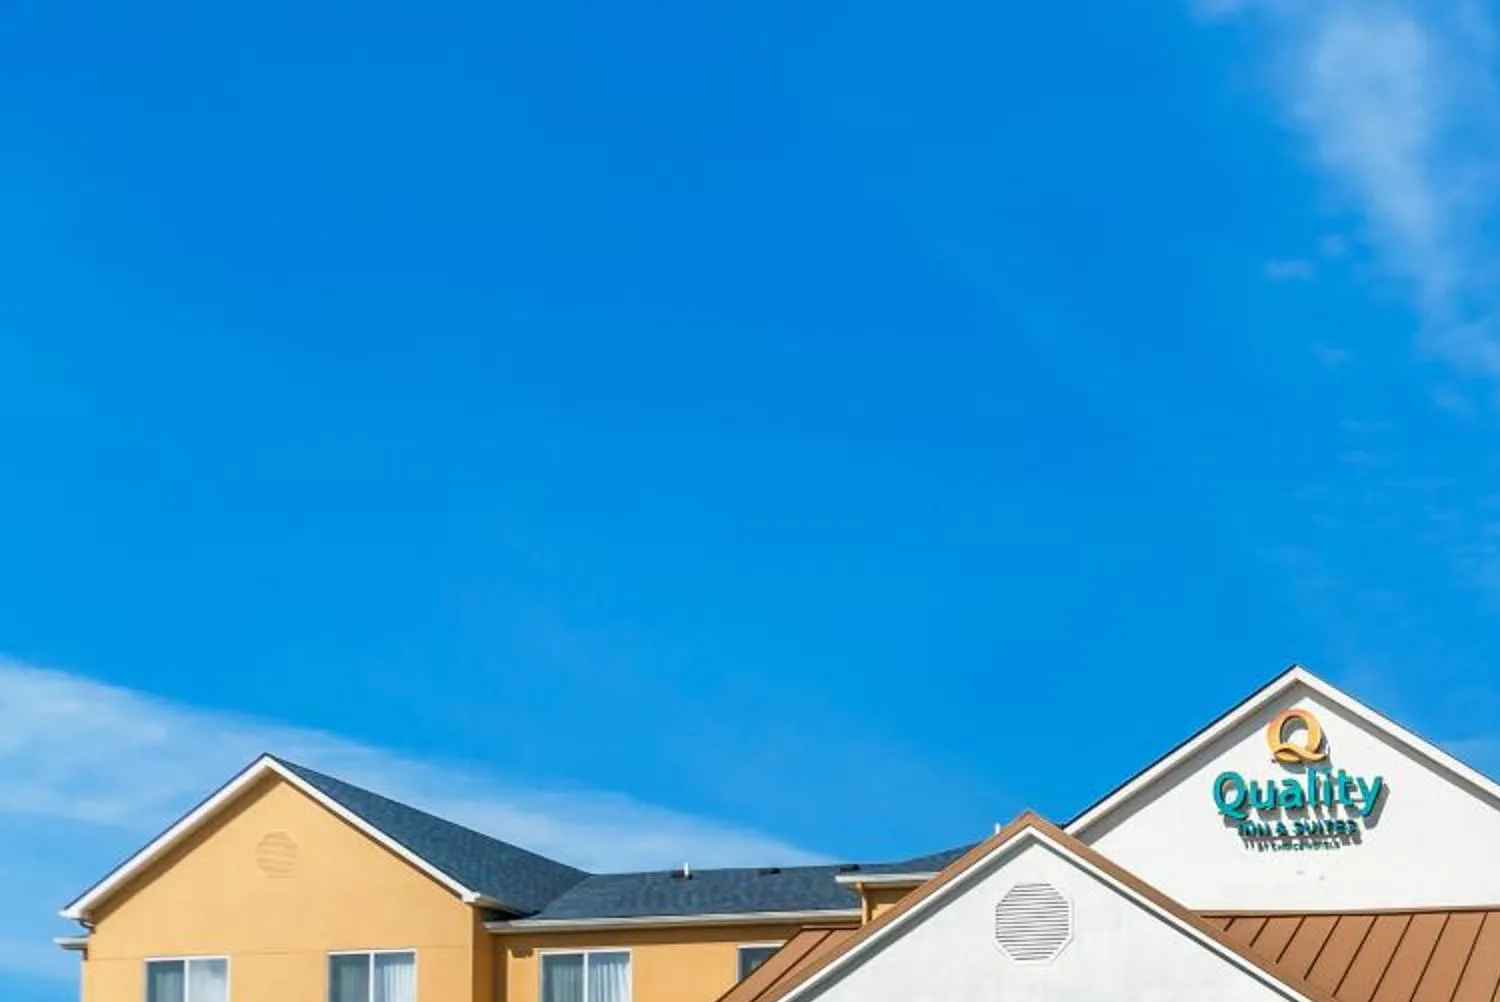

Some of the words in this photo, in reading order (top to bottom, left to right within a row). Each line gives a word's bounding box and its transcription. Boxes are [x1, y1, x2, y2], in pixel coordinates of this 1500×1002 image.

[1266, 708, 1327, 763] Q
[1213, 767, 1383, 821] Quality
[1293, 818, 1358, 836] SUITES
